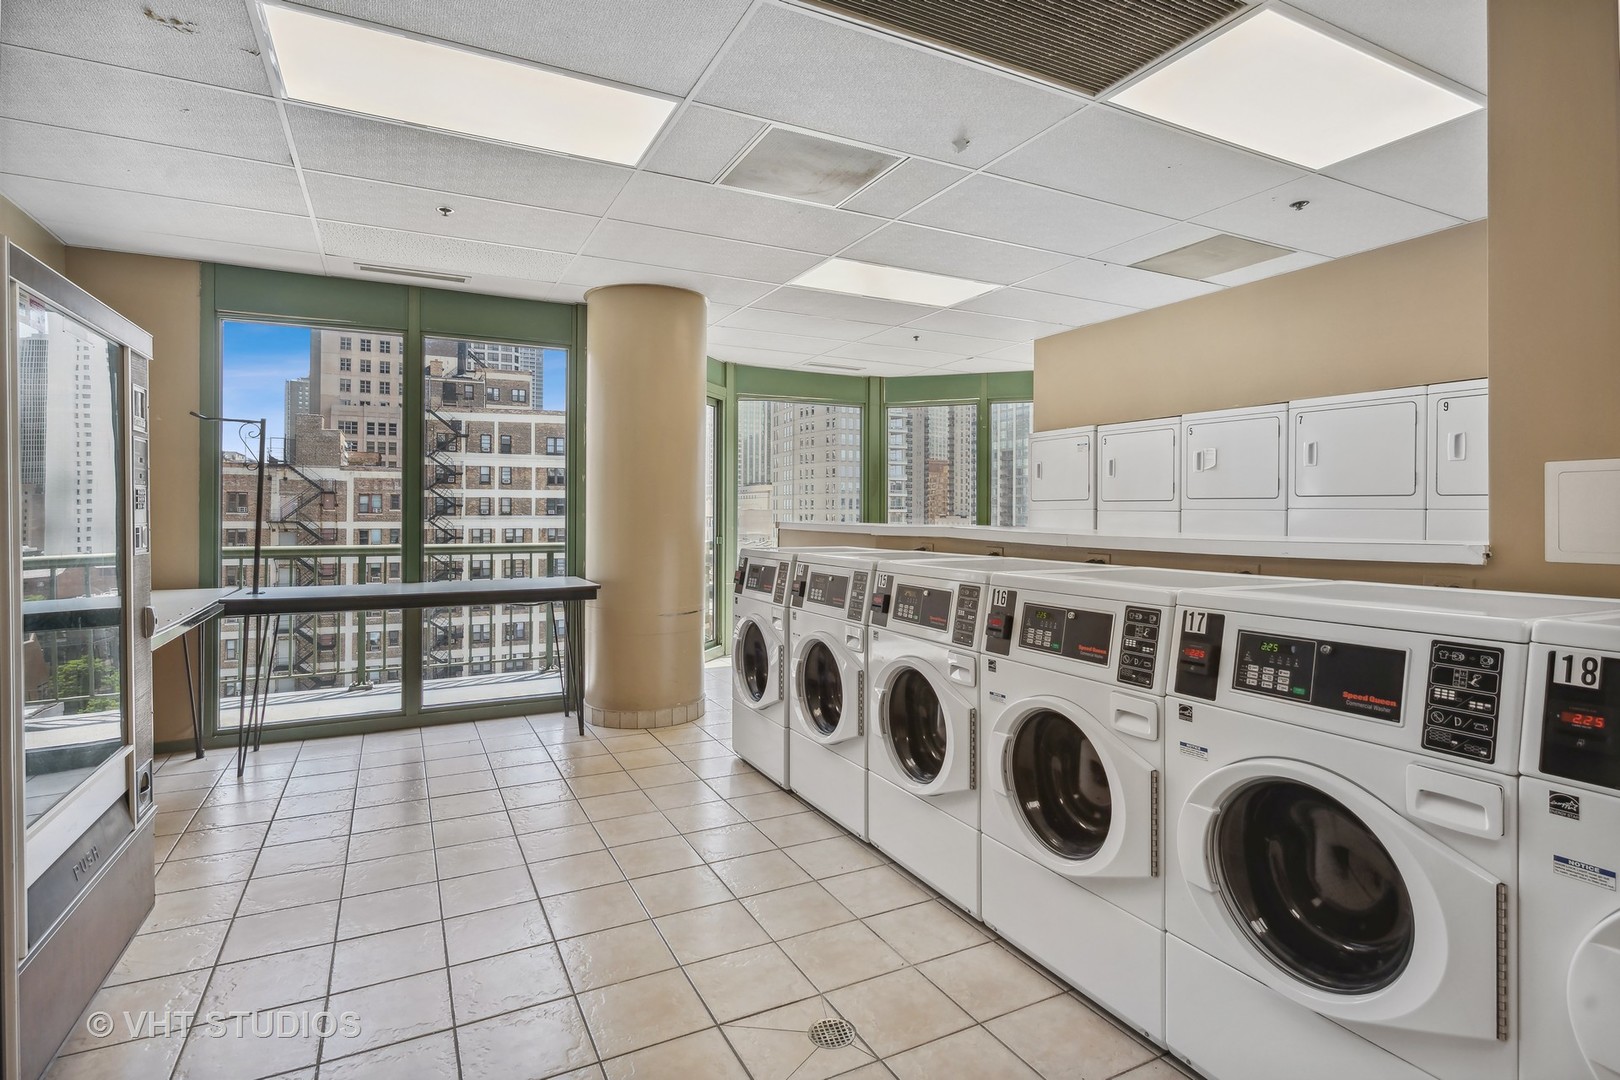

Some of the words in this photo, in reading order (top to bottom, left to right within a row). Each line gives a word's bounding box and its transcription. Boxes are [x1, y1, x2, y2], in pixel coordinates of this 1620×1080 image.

[1443, 401, 1449, 412] 9
[1299, 415, 1304, 425] 7
[1189, 427, 1193, 436] 5
[996, 590, 1007, 605] 16
[1189, 611, 1206, 632] 17
[1562, 654, 1599, 686] 18
[1343, 690, 1369, 702] Speed
[1369, 695, 1397, 707] Queen
[72, 845, 100, 882] PUSH
[1568, 859, 1601, 874] NOTICE
